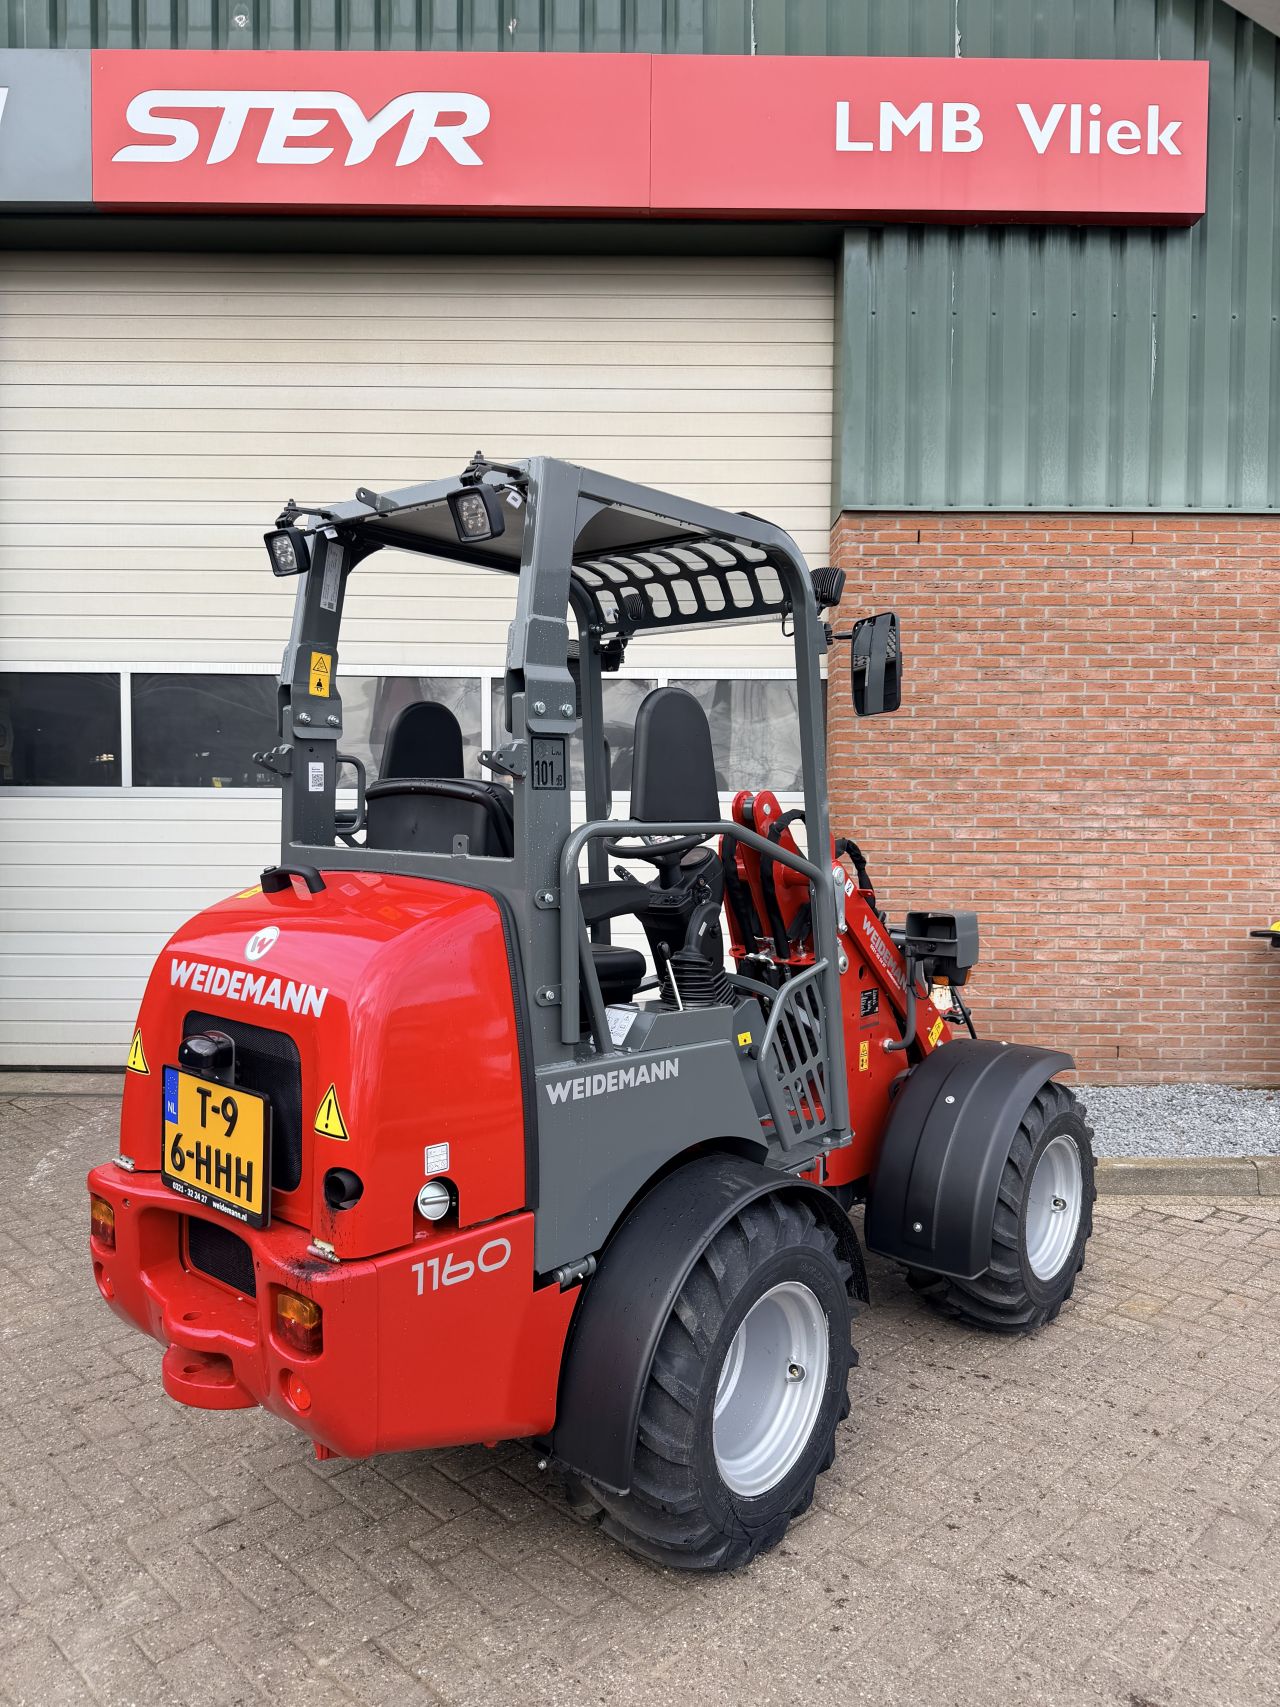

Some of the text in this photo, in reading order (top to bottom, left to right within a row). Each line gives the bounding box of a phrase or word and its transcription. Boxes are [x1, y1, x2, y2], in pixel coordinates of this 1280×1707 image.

[111, 89, 491, 167] STEYR
[835, 101, 1183, 156] LMB Vliek
[535, 760, 554, 786] 101
[862, 914, 908, 990] WEIDEMAN
[170, 958, 329, 1019] WEIDEMANN
[167, 1100, 177, 1115] NL
[545, 1057, 679, 1105] WEIDEMANN
[196, 1086, 239, 1138] T-9
[171, 1132, 254, 1203] 6-HHH
[201, 1194, 208, 1204] 27
[212, 1201, 248, 1222] weidemann.nl
[411, 1238, 512, 1296] 1160
